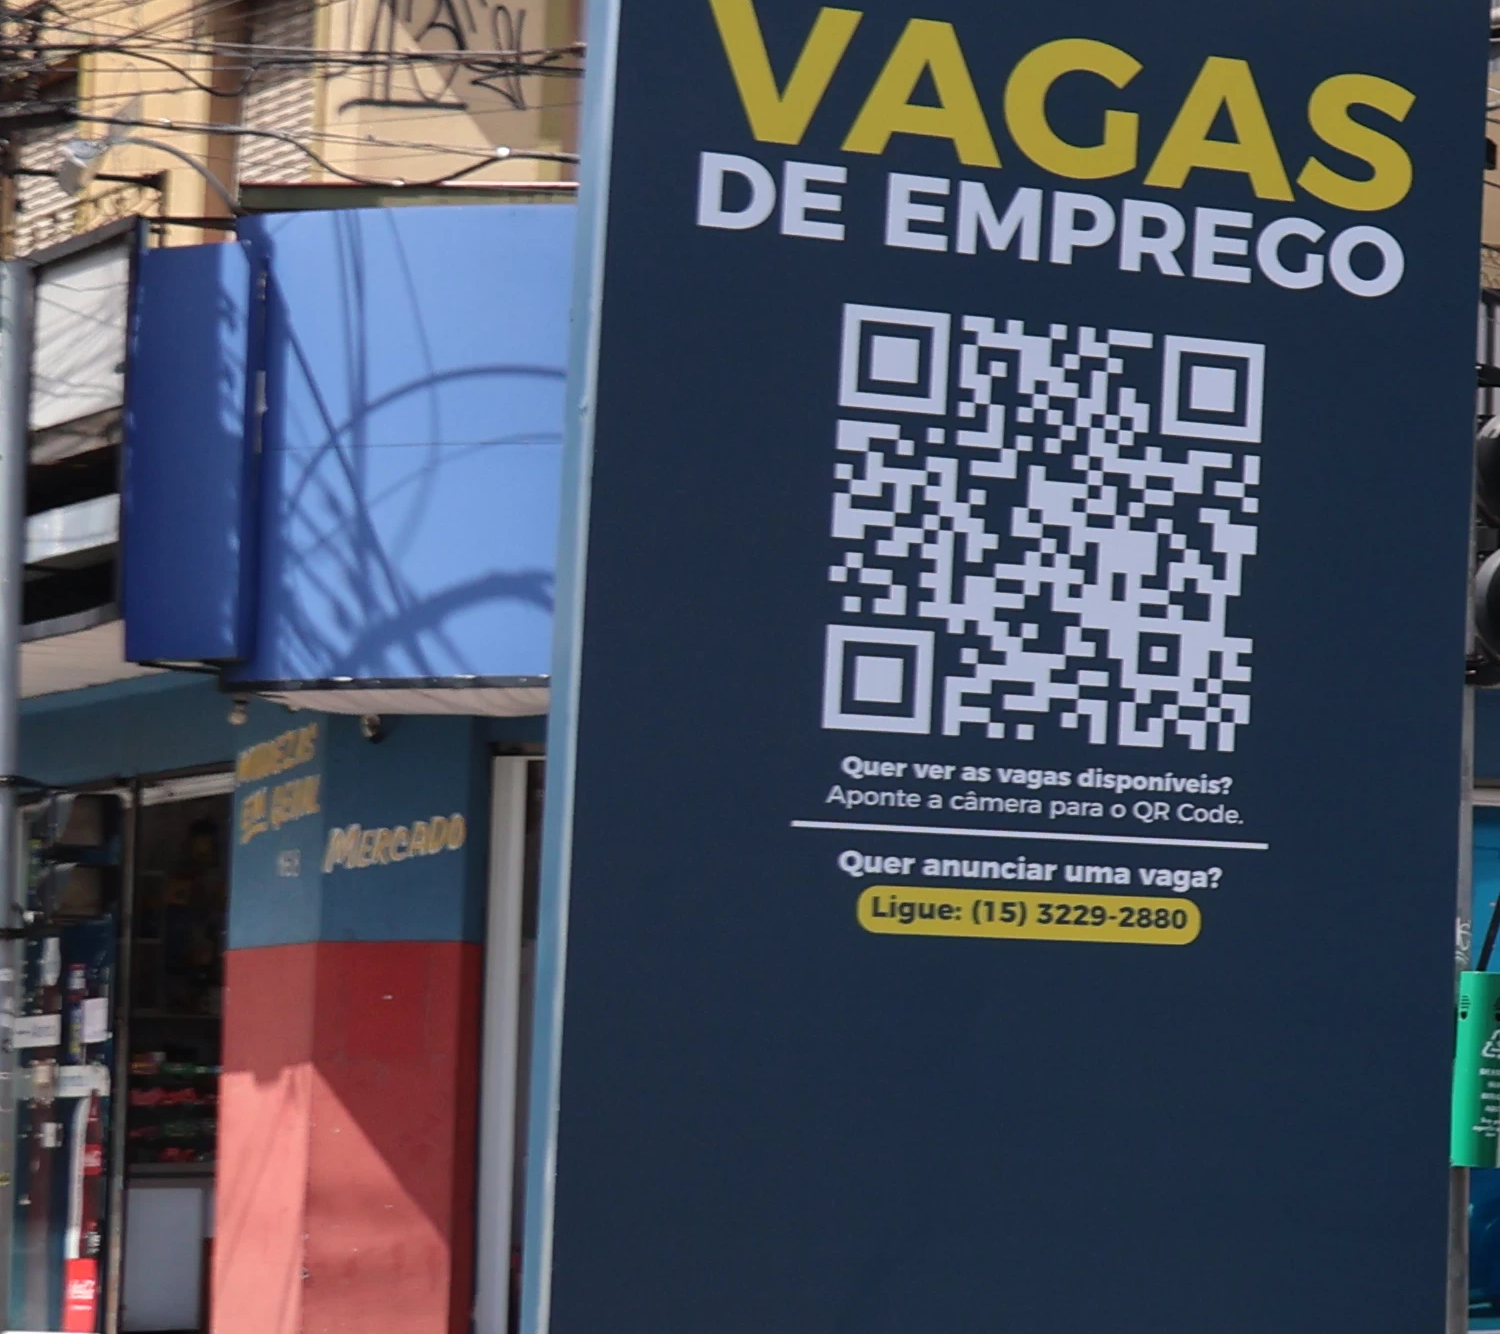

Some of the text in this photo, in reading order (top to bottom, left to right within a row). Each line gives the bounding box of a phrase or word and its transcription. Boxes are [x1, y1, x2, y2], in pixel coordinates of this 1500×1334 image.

[696, 151, 1405, 297] DE EMPREGO
[842, 755, 1234, 795] Quer ver as vagas disponíveis?
[825, 785, 1244, 825] Aponte a câmera para o QR Code.
[322, 813, 467, 874] MERCADO
[838, 850, 1223, 893] Quer anunciar uma vaga?
[871, 896, 1188, 930] Ligue: (15) 3229-2880
